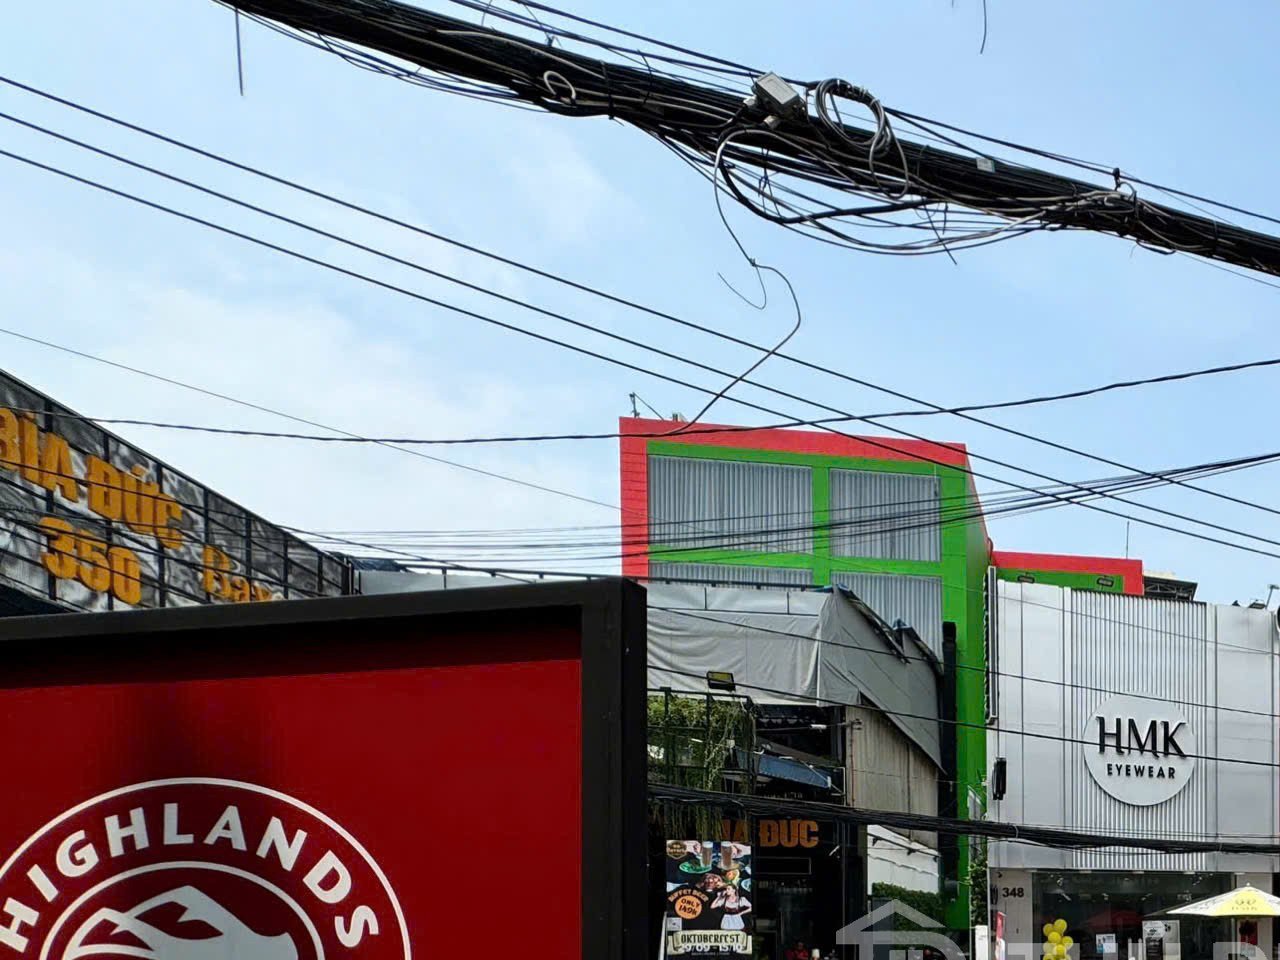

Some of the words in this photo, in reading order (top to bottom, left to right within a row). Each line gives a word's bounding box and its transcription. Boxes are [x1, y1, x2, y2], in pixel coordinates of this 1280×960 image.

[39, 516, 141, 605] 350
[1096, 716, 1188, 758] HMK
[1107, 763, 1176, 780] EYEWEAR
[0, 803, 379, 953] HIGHLANDS
[1002, 887, 1025, 898] 348
[681, 934, 740, 944] OKTOBERFEST
